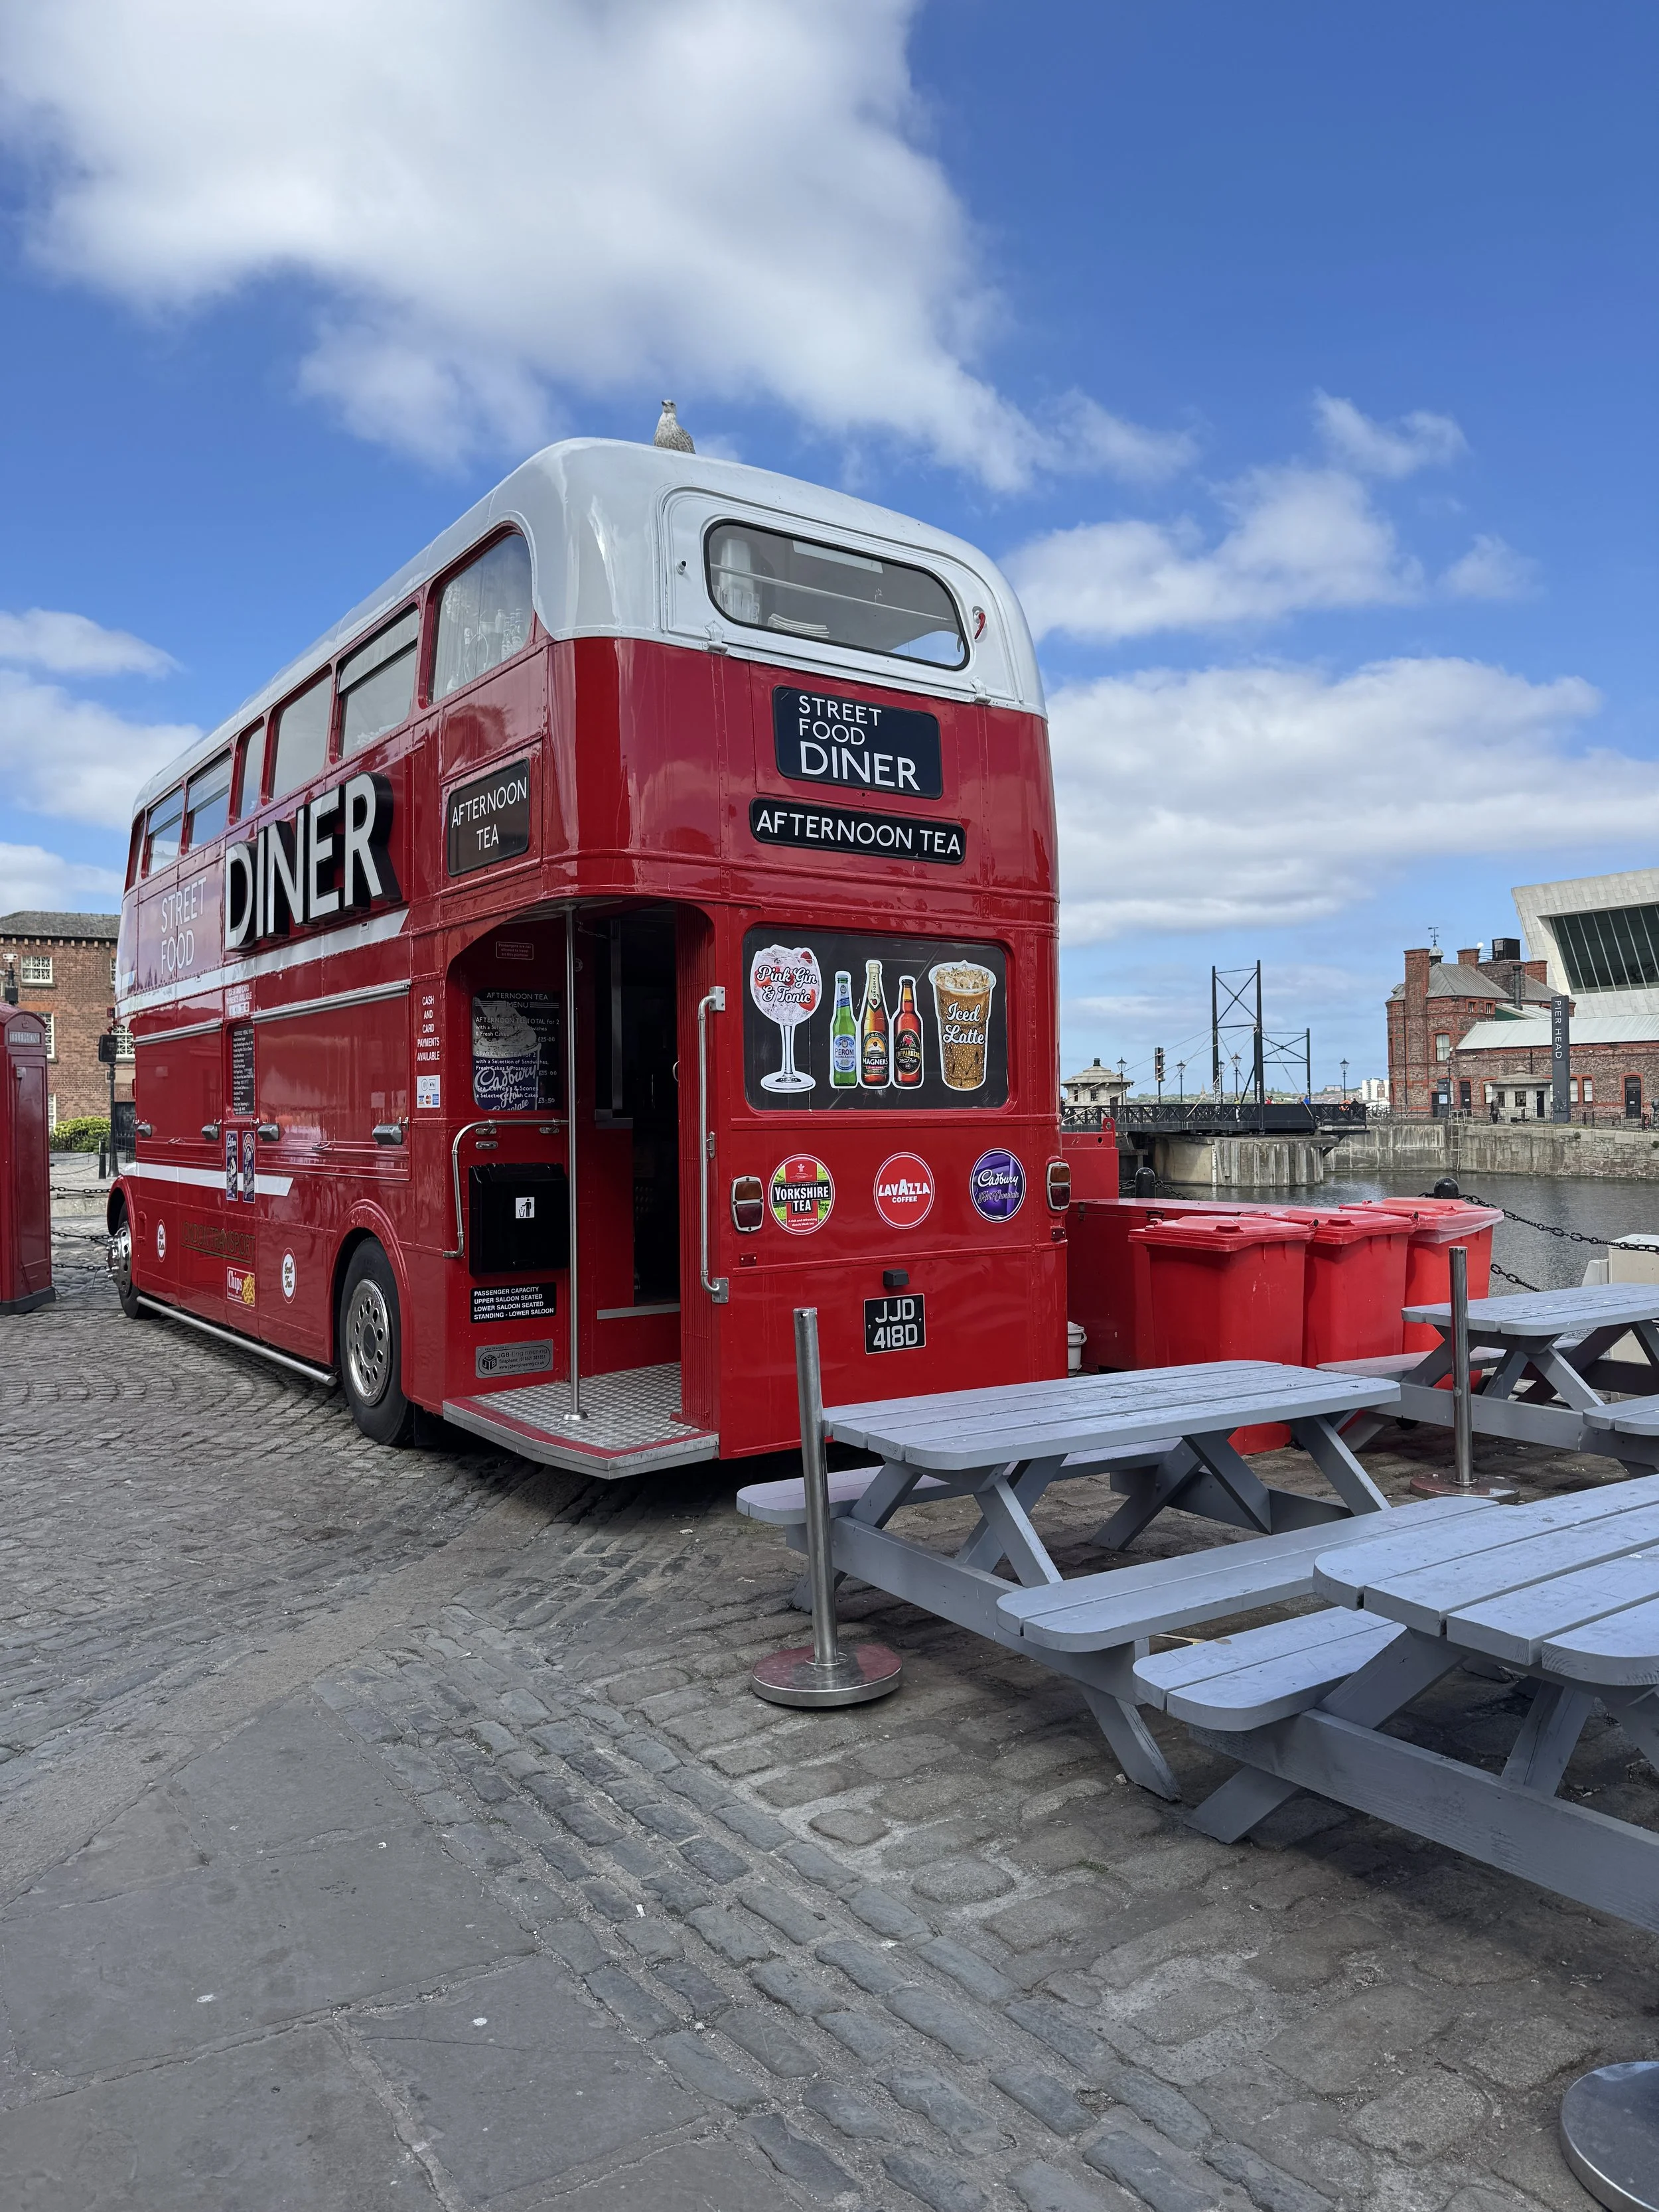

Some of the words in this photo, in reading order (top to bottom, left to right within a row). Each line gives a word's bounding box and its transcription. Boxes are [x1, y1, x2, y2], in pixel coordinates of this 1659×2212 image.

[798, 696, 882, 726] STREET
[799, 717, 865, 745] FOOD
[800, 741, 920, 791] DINER
[451, 776, 527, 828] AFTERNOON
[476, 824, 499, 851] TEA
[756, 809, 912, 850] AFTERNOON
[919, 830, 961, 855] TEA
[225, 771, 386, 952] DINER
[161, 876, 206, 933] STREET
[161, 929, 194, 975] FOOD
[756, 965, 791, 982] Pink
[792, 967, 818, 988] Gin
[422, 995, 435, 1005] CASH
[762, 985, 775, 1001] &
[777, 986, 812, 1003] Tonic
[423, 1009, 433, 1019] AND
[946, 1001, 981, 1022] Iced
[10, 1032, 39, 1043] TELEPHONE
[422, 1023, 435, 1033] CARD
[942, 1024, 985, 1045] Latte
[417, 1037, 440, 1048] PAYMENTS
[417, 1051, 440, 1062] AVAILABLE
[863, 1057, 889, 1065] MAGNERS
[474, 1065, 537, 1093] Cadbury
[878, 1179, 931, 1197] LAVAZZA
[977, 1169, 1019, 1187] Cadbury
[774, 1186, 829, 1201] YORKSHIRE
[977, 1191, 992, 1204] Hot
[992, 1189, 1019, 1203] Chocolate
[793, 1199, 812, 1212] TEA
[228, 1270, 243, 1294] Chips
[875, 1298, 915, 1323] JJD
[873, 1323, 918, 1349] 418D
[511, 1349, 548, 1357] Engineering
